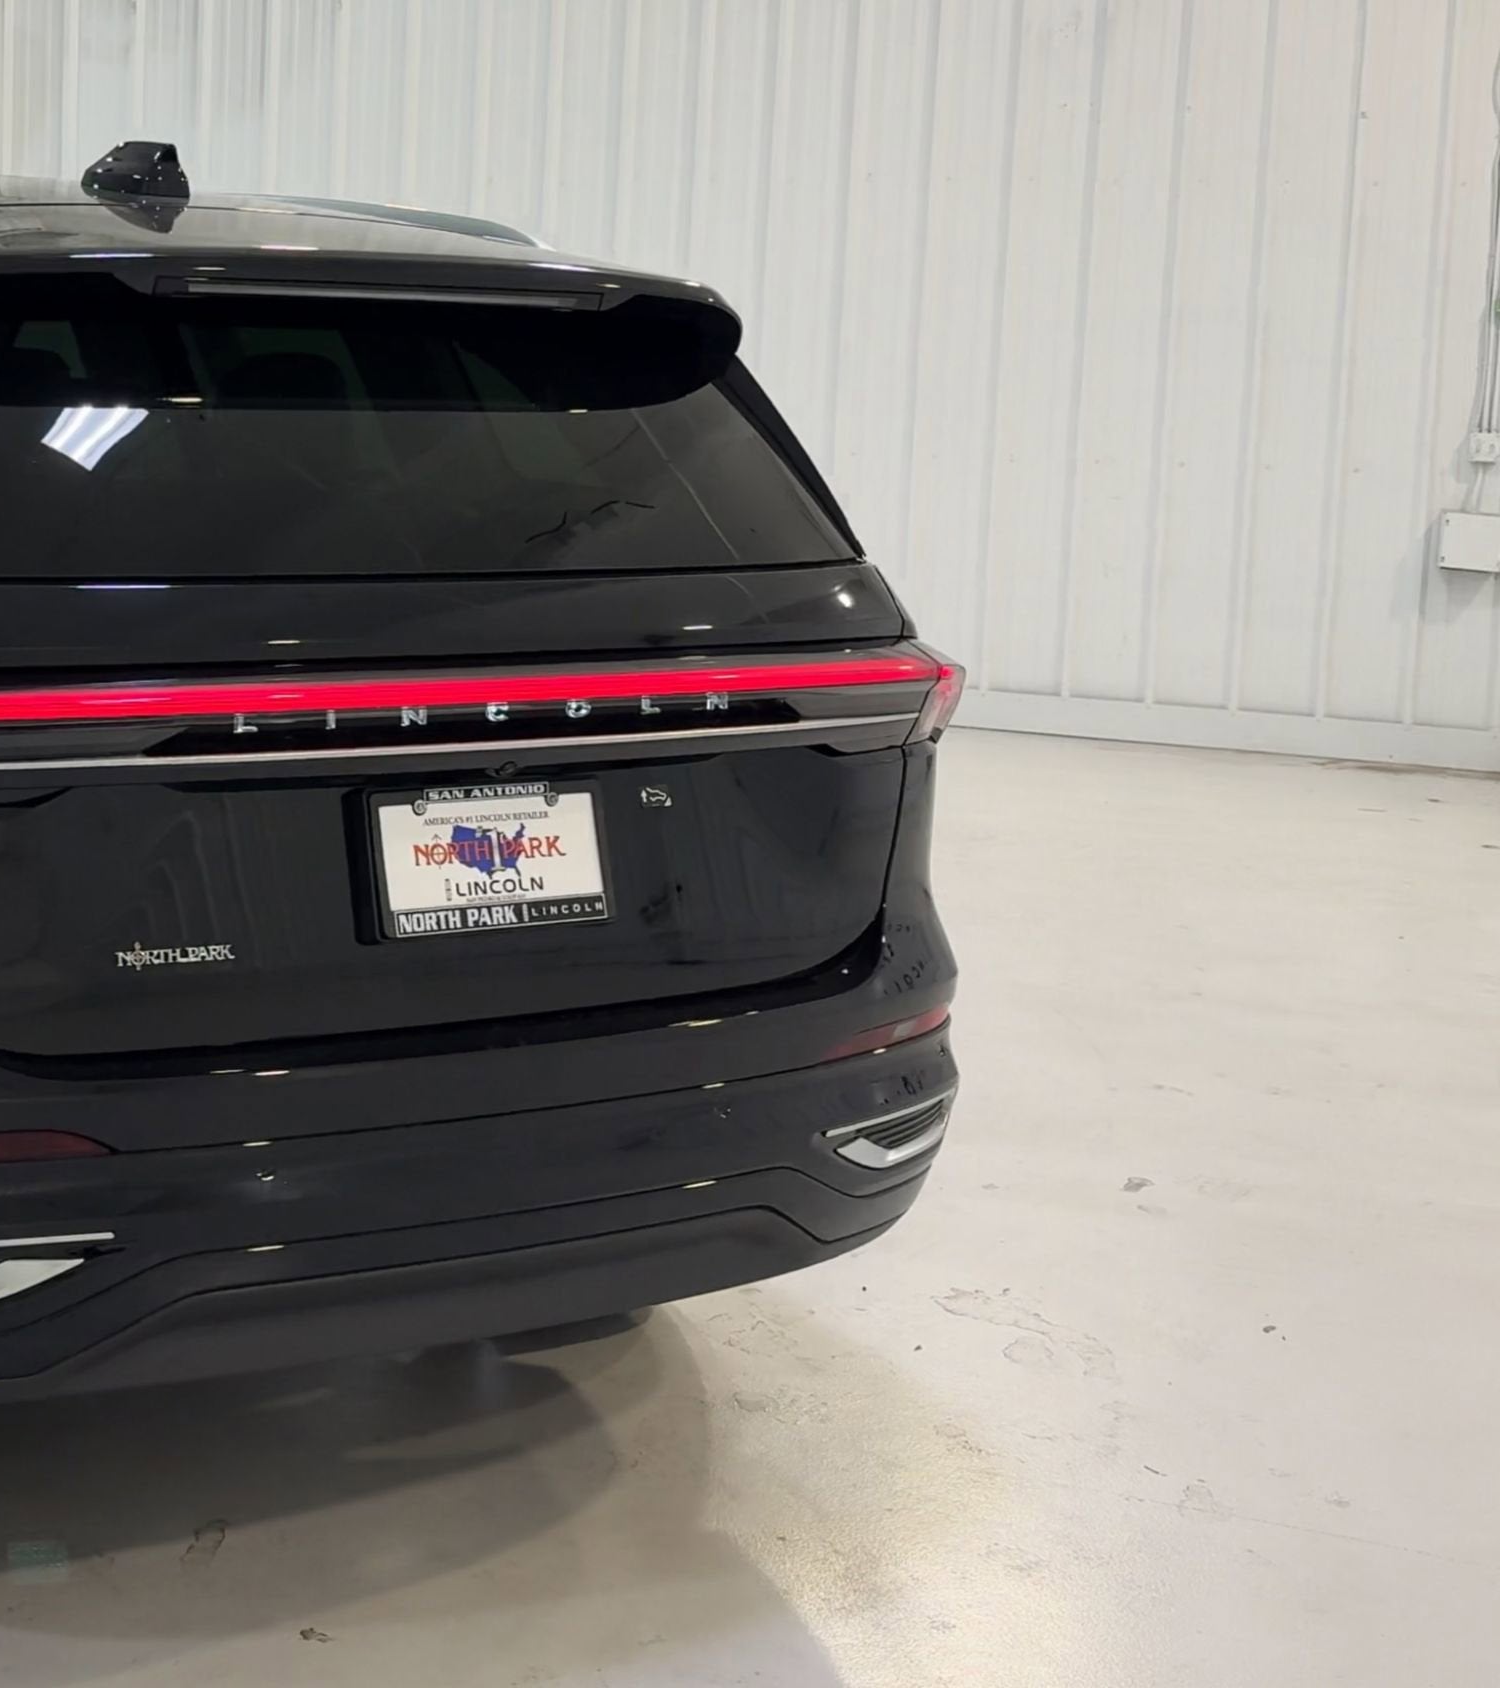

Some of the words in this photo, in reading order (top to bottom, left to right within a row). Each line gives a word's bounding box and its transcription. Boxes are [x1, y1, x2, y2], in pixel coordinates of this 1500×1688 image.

[233, 691, 729, 733] LINCOLN
[428, 789, 465, 801] SAN
[470, 784, 546, 798] ANTONIO
[475, 812, 512, 824] LINCOLN
[513, 810, 550, 821] RETAILER
[412, 839, 490, 867] NORTH
[501, 835, 567, 859] PARK
[455, 877, 544, 897] LINCOLN
[398, 908, 462, 934] NORTH
[467, 903, 518, 928] PARK
[531, 901, 603, 916] LINCOLN
[114, 946, 182, 968] NORTH
[185, 944, 235, 962] PARK
